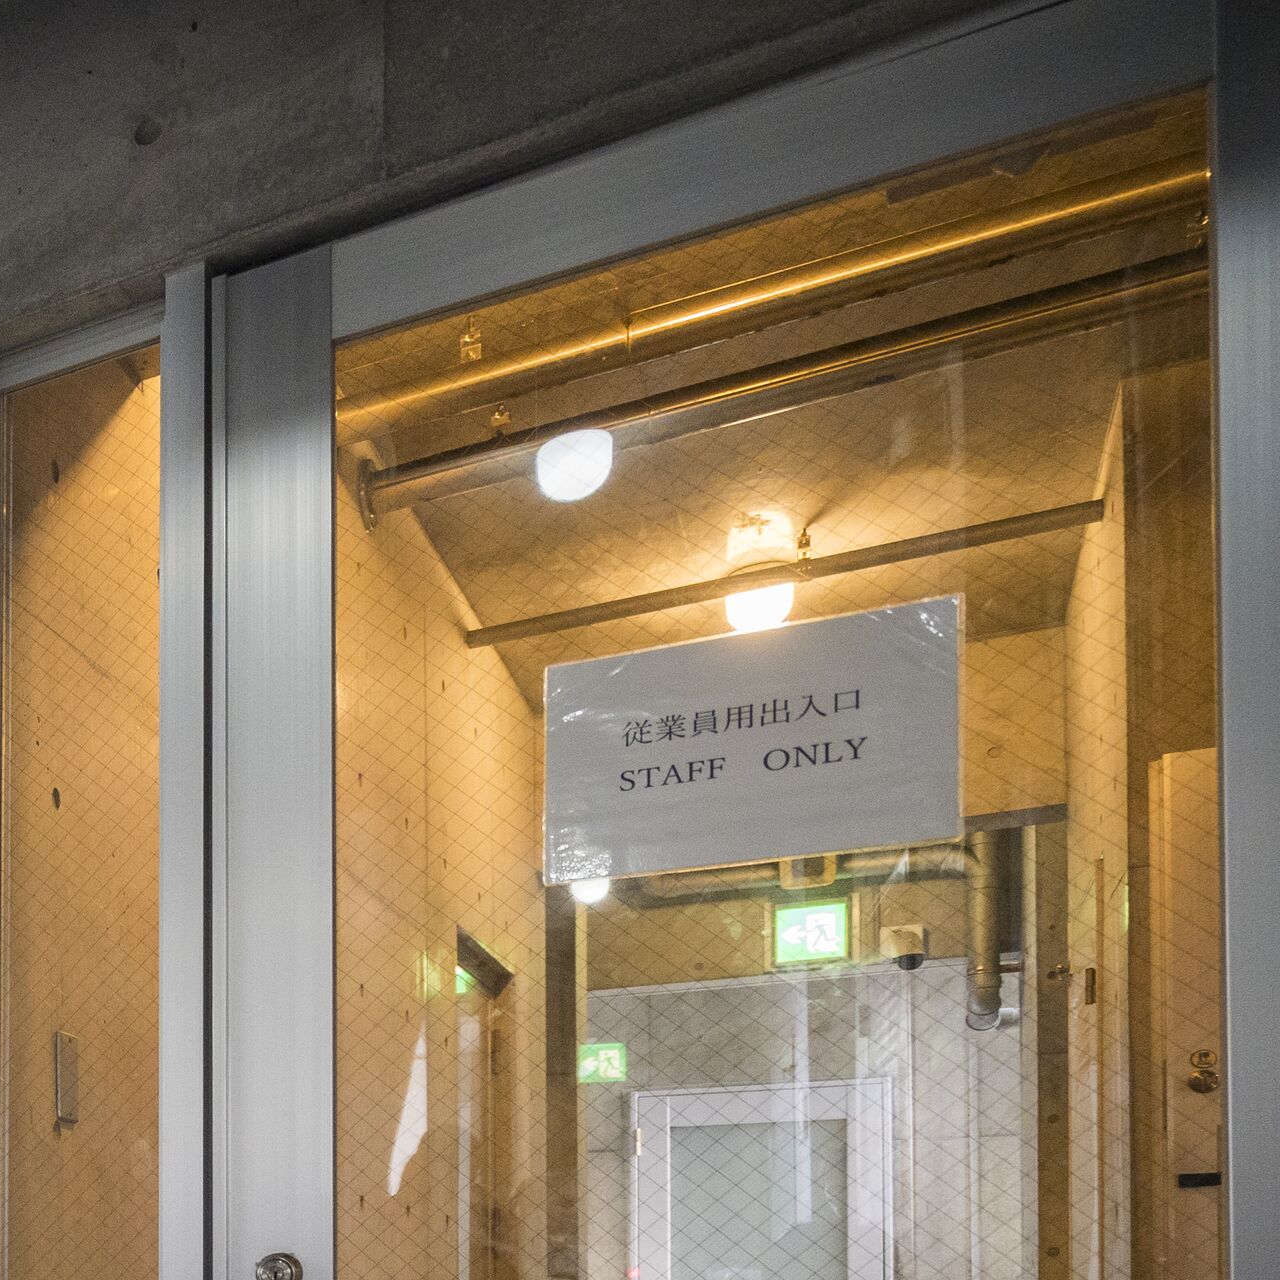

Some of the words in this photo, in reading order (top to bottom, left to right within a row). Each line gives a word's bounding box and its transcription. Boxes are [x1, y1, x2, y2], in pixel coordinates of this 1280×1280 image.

[621, 689, 860, 748] 従業員用出入口
[619, 757, 726, 792] STAFF
[762, 736, 869, 772] ONLY
